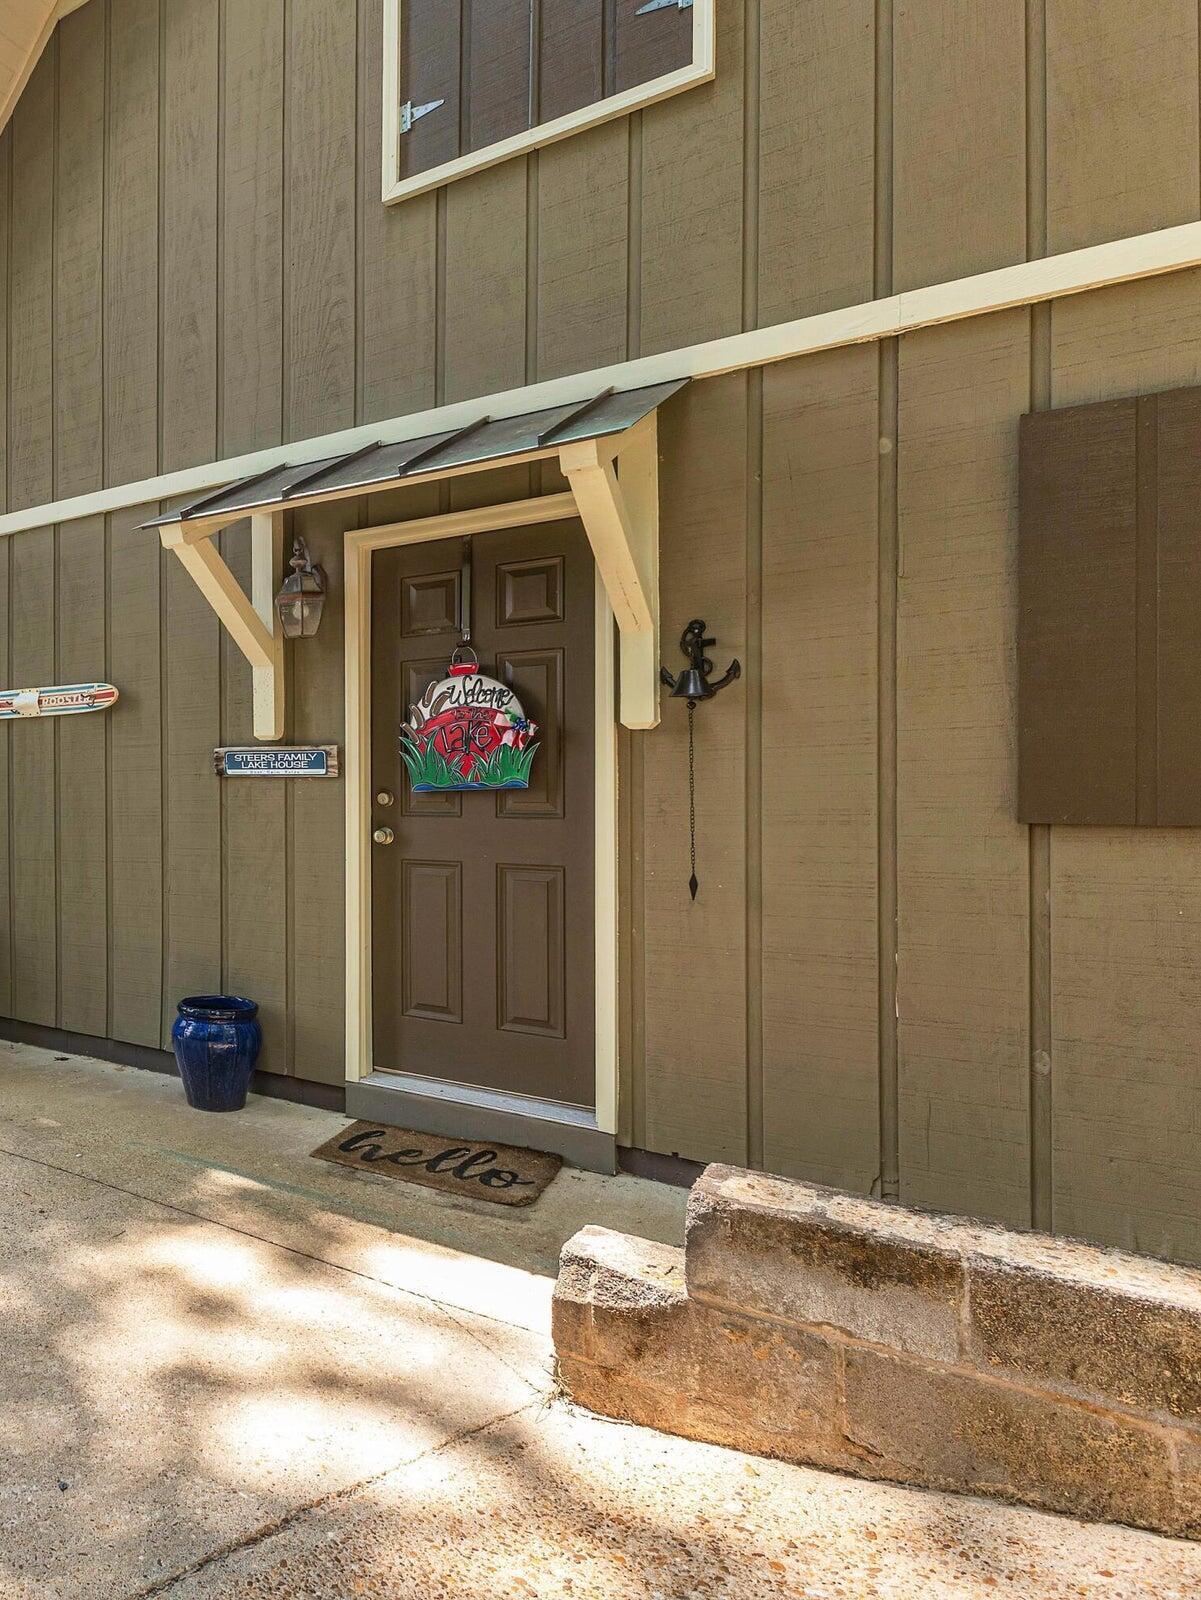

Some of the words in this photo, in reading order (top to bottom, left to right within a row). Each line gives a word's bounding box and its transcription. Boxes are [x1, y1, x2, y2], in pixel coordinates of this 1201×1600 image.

[447, 675, 513, 707] Welcome
[234, 754, 275, 762] STEERS
[277, 753, 317, 761] FAMILY
[241, 761, 268, 769] LAKE
[271, 761, 309, 769] HOUSE
[340, 1131, 534, 1188] hello
